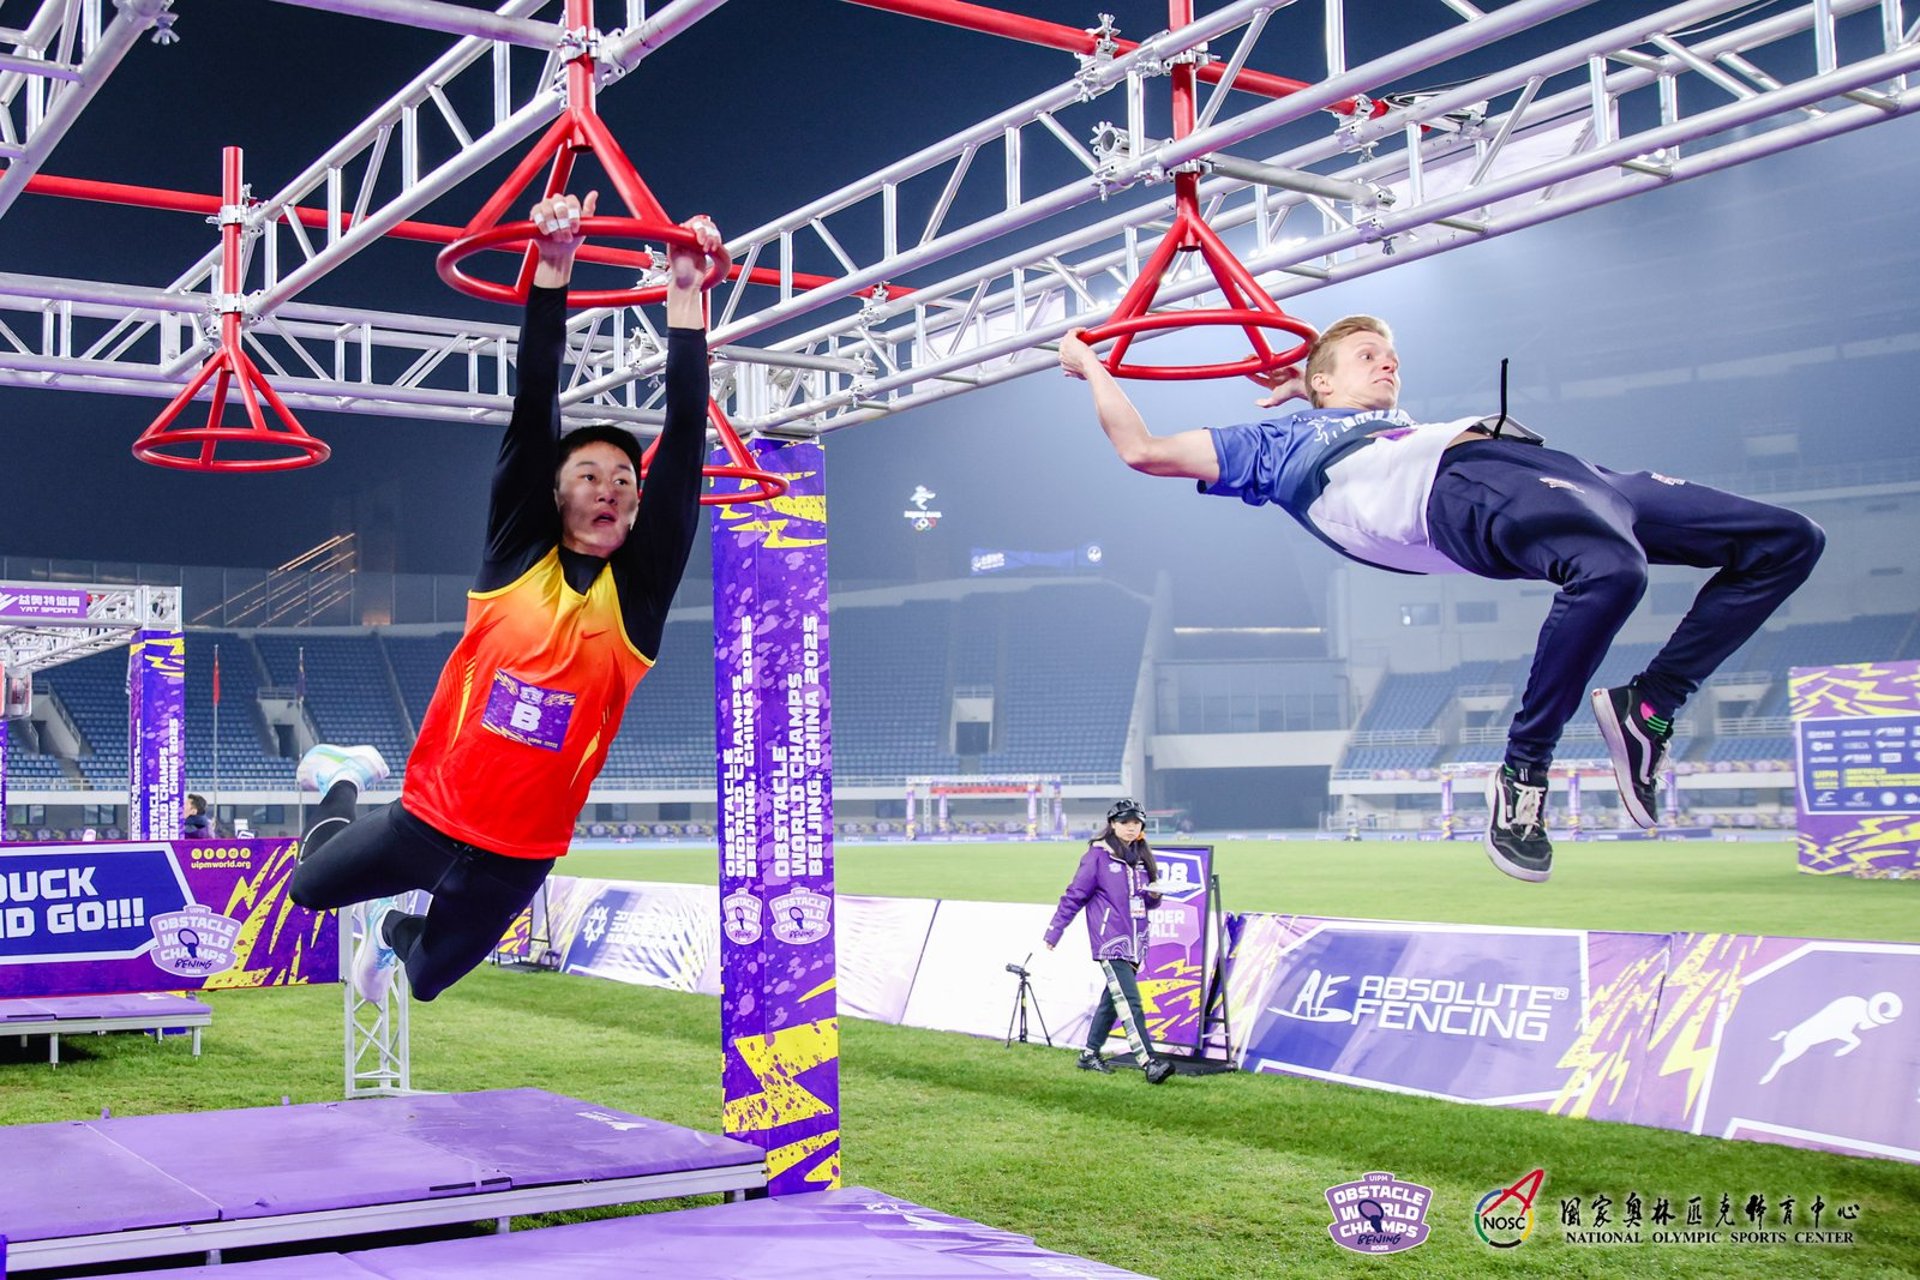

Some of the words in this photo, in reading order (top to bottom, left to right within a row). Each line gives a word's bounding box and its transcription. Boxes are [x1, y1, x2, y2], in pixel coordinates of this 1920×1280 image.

[741, 615, 753, 684] 2025
[803, 615, 819, 684] 2025
[169, 718, 179, 754] 2025
[511, 701, 542, 732] B
[732, 675, 744, 780] CHAMPS
[743, 690, 755, 767] CHINA
[787, 673, 804, 779] CHAMPS
[804, 690, 821, 766] CHINA
[159, 747, 169, 800] CHAMPS
[169, 756, 179, 794] CHINA
[149, 783, 159, 840] BSTACLE
[159, 803, 169, 840] ORLD
[169, 797, 179, 840] EIJING,
[723, 748, 736, 877] OBSTACLE
[734, 786, 746, 877] WORLD
[745, 772, 757, 878] BEIJING,
[772, 746, 790, 877] OBSTACLE
[790, 785, 806, 876] WORLD
[806, 772, 824, 876] BEIJING,
[0, 866, 99, 904] UCK
[191, 860, 251, 870] uipmworld.org
[47, 897, 145, 934] GO!!!
[158, 917, 235, 937] OBSTACLE
[1149, 924, 1179, 937] ALL
[161, 947, 228, 964] CHAMPS
[1351, 998, 1551, 1042] FENCING
